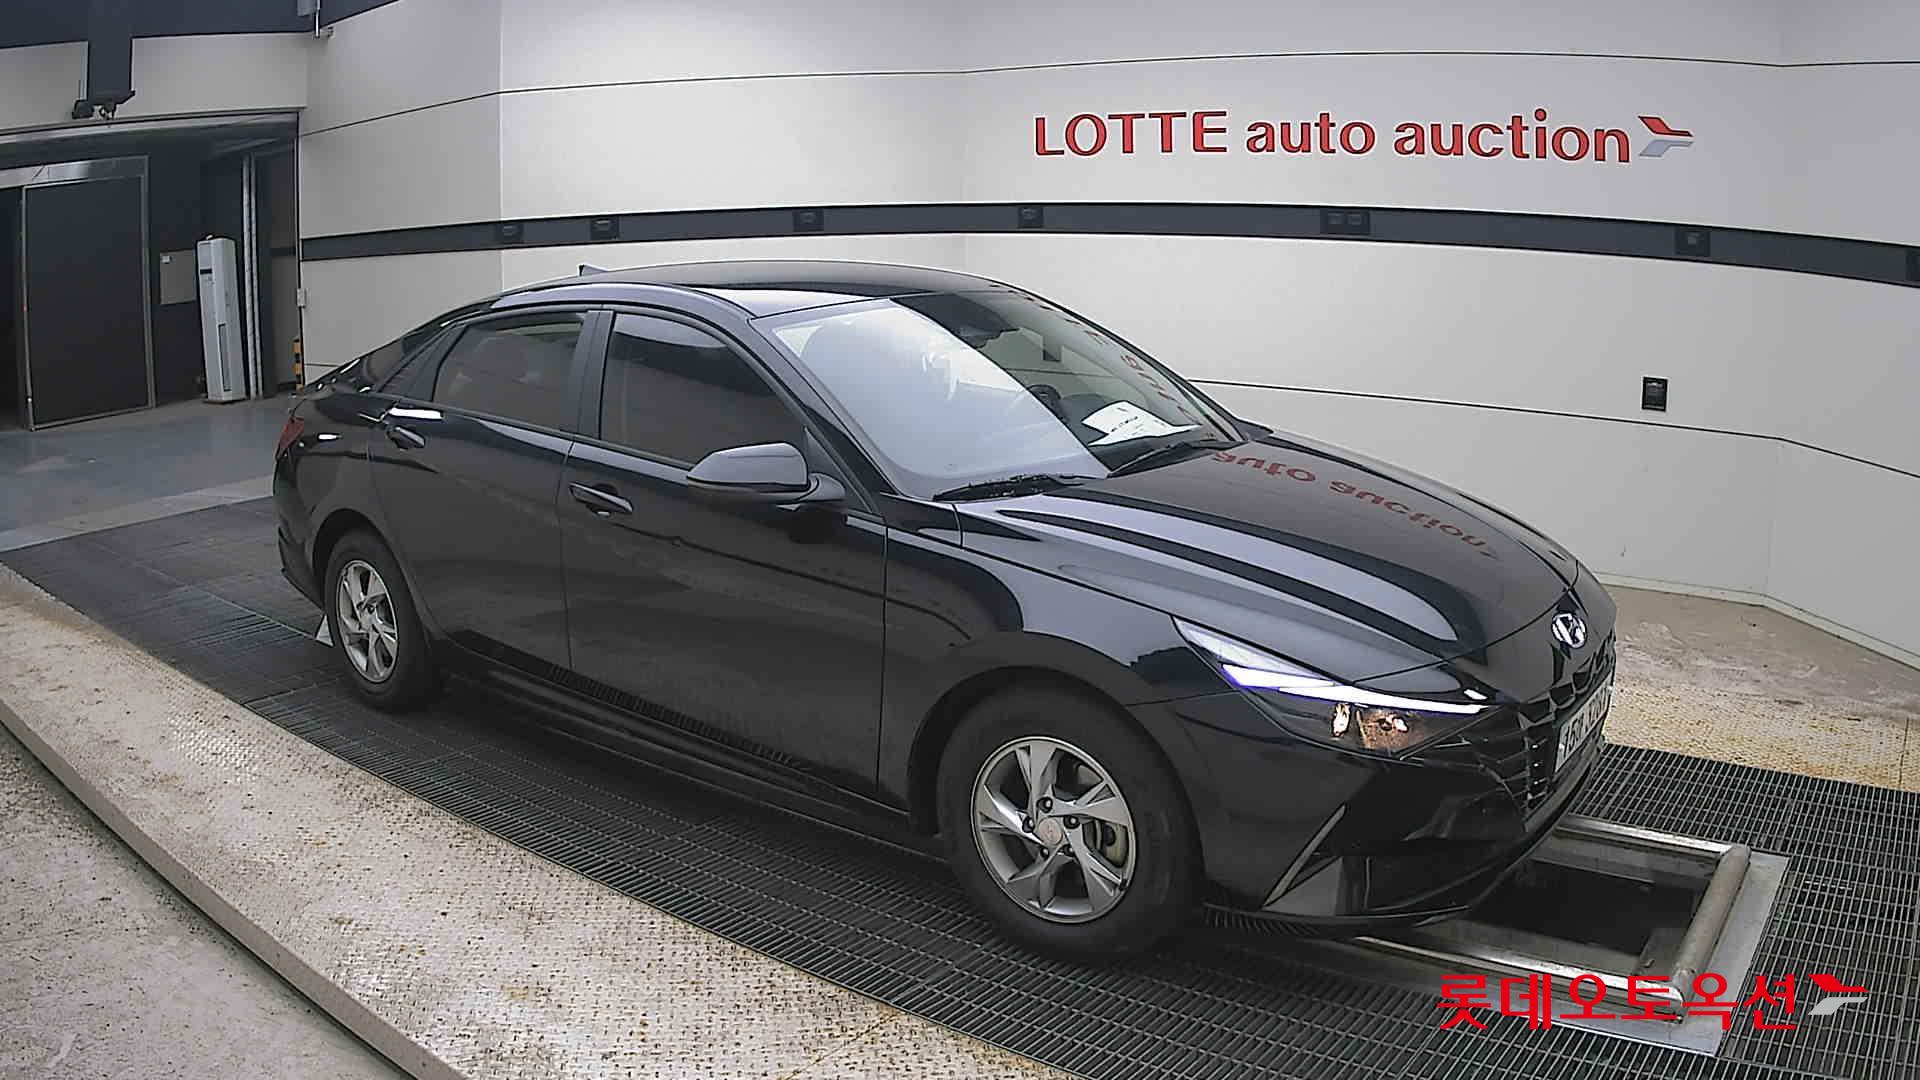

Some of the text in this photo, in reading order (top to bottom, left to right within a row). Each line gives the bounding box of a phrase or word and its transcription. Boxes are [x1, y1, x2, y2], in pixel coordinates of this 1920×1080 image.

[1034, 108, 1631, 163] LOTTE auto auction
